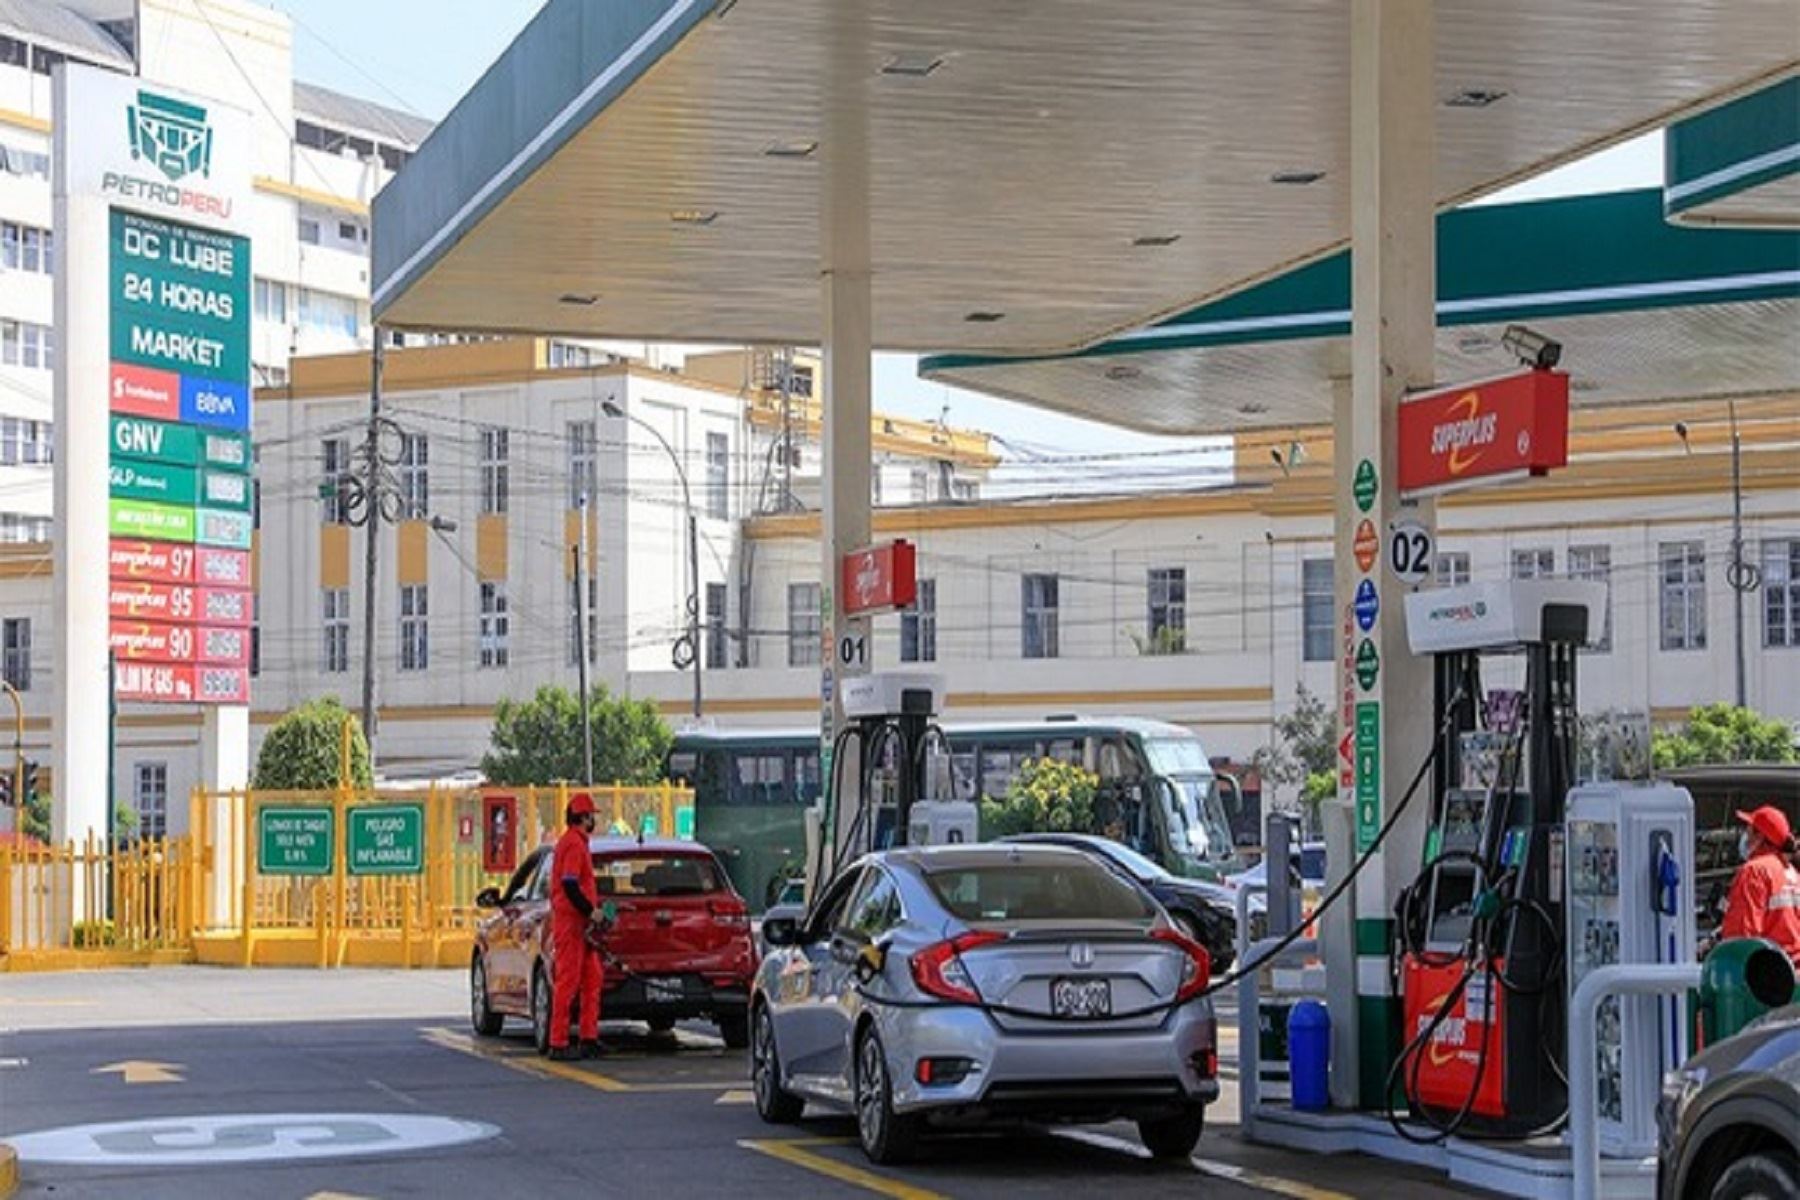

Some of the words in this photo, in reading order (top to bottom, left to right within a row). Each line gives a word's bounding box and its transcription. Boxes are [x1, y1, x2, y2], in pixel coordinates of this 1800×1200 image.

[124, 226, 160, 260] DC
[169, 238, 233, 278] LUBE
[124, 272, 153, 303] 24
[161, 280, 233, 319] HORAS
[131, 325, 224, 367] MARKET
[115, 421, 164, 454] GNV
[1431, 411, 1498, 455] SUPERPLUS
[171, 547, 194, 577] 97
[1391, 531, 1430, 573] 02
[171, 587, 193, 617] 95
[169, 627, 192, 659] 90
[841, 637, 865, 664] 01
[365, 818, 406, 832] PELIGRO
[375, 833, 395, 847] GAS
[356, 847, 413, 863] INFLAMABLE
